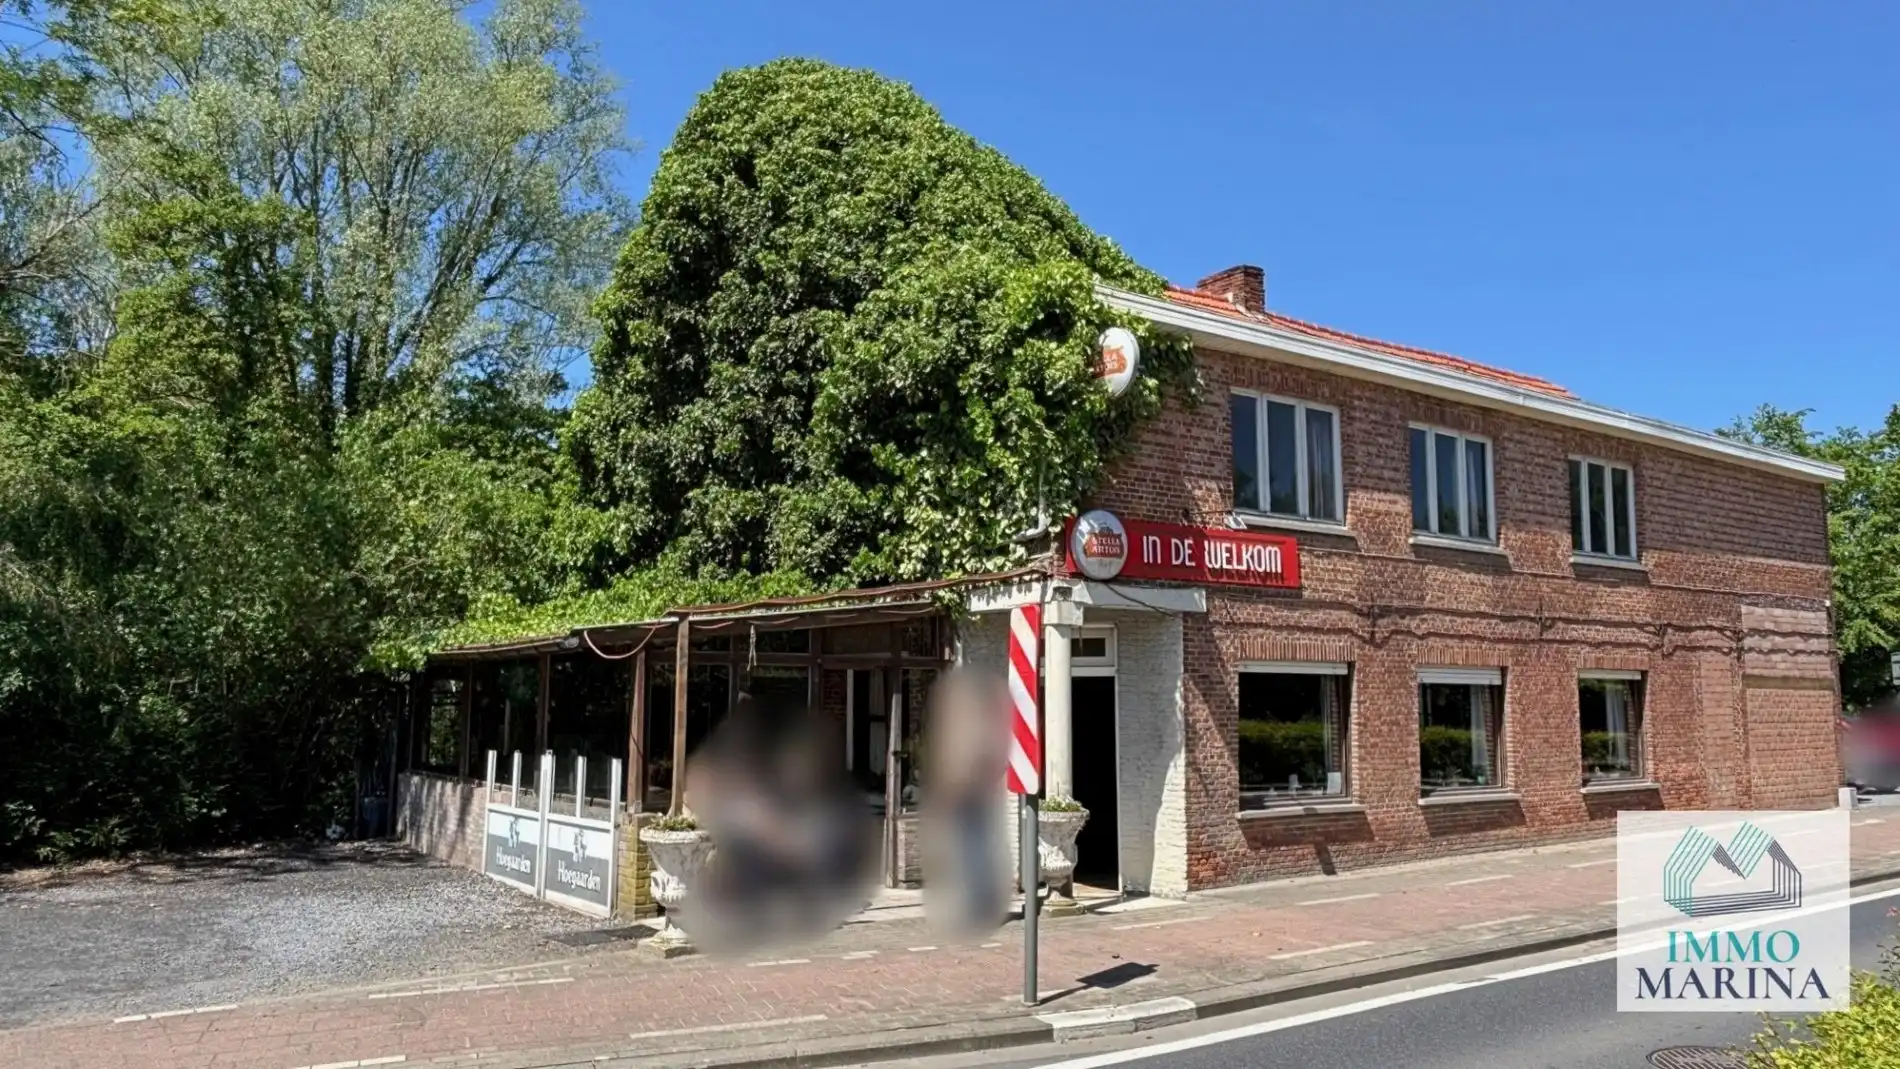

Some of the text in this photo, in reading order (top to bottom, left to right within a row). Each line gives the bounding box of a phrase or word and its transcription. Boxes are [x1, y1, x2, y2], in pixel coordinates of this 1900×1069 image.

[1143, 535, 1282, 573] IN DE WELKOM
[496, 846, 531, 873] Hoegaarden
[558, 860, 601, 891] Hoegaarden
